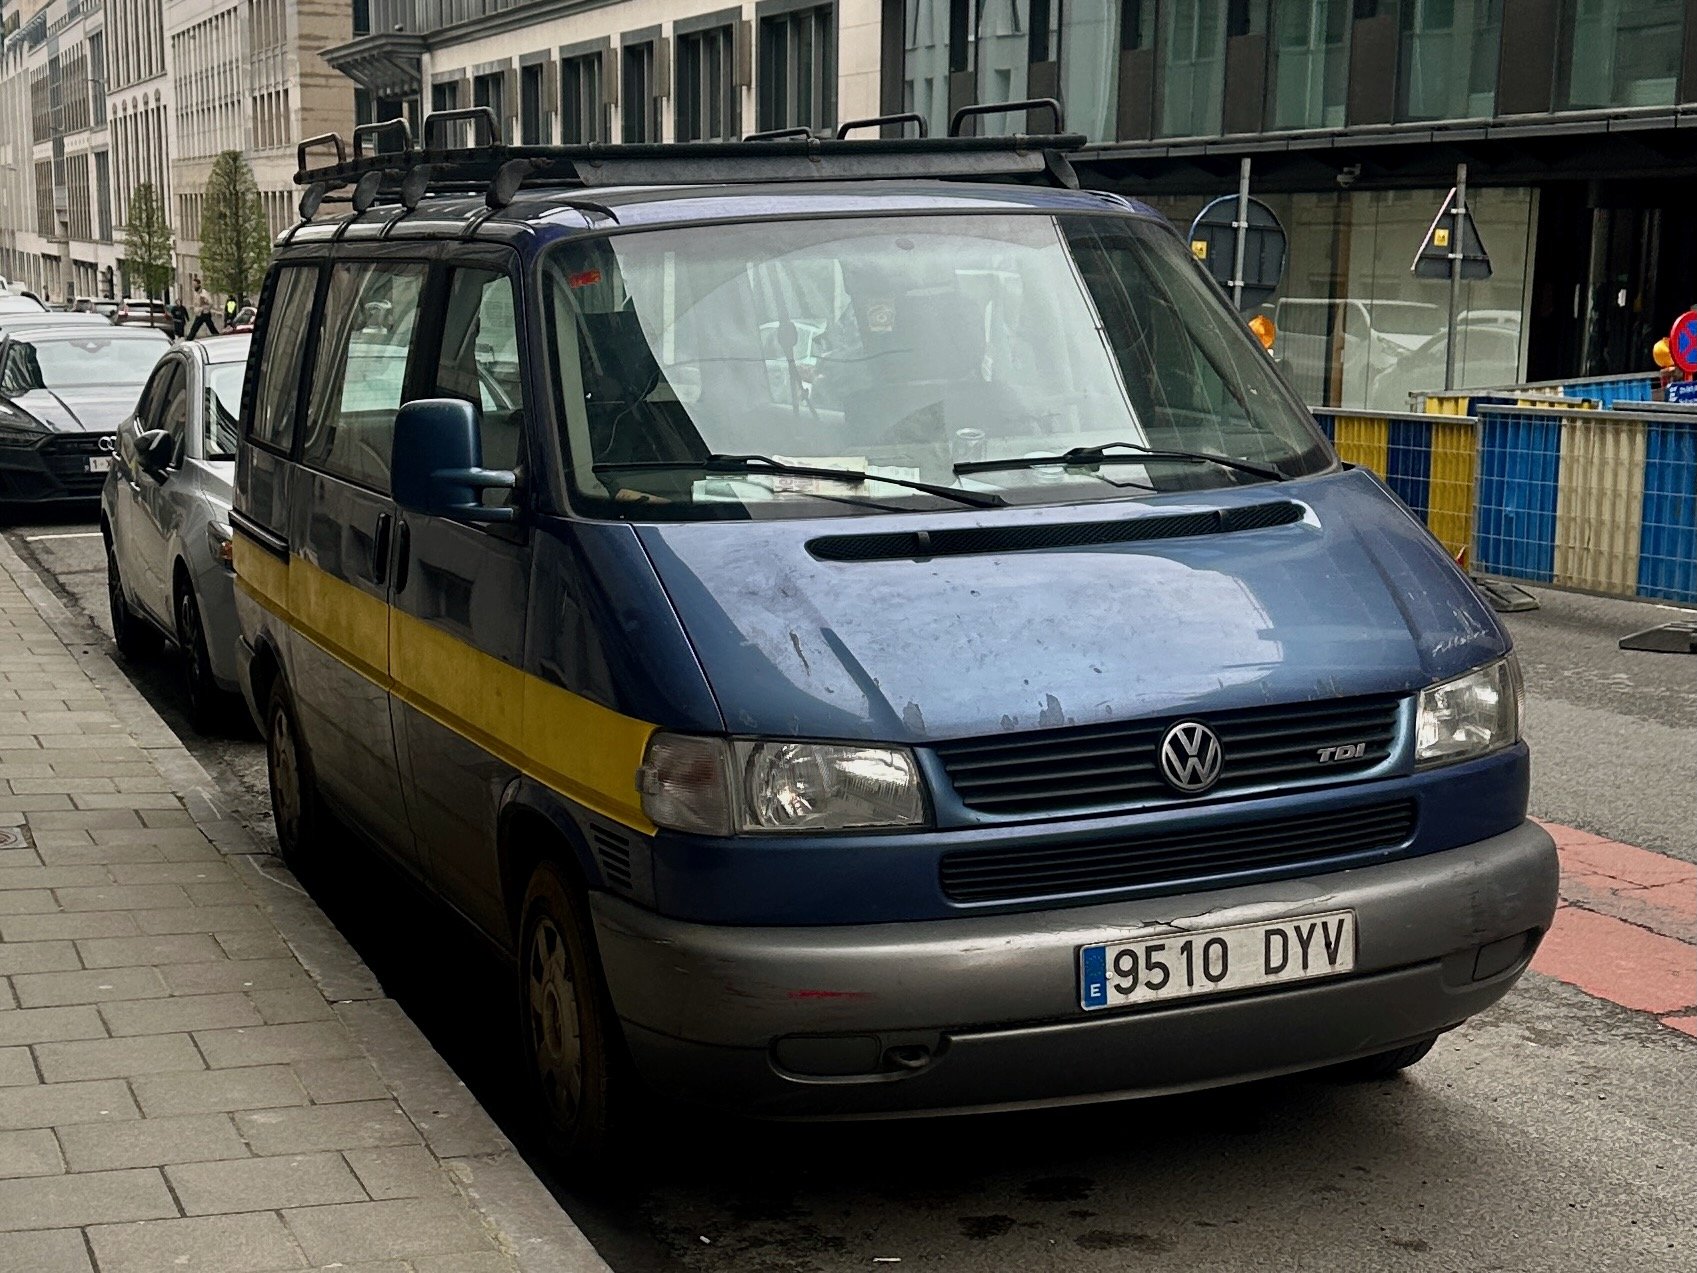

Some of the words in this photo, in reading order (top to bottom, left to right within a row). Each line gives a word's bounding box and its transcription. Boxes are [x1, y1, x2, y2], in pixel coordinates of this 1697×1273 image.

[1163, 724, 1220, 788] VW
[1317, 742, 1366, 763] TDI
[1090, 984, 1101, 997] E
[1113, 937, 1229, 995] 9510
[1264, 918, 1345, 976] DYV
